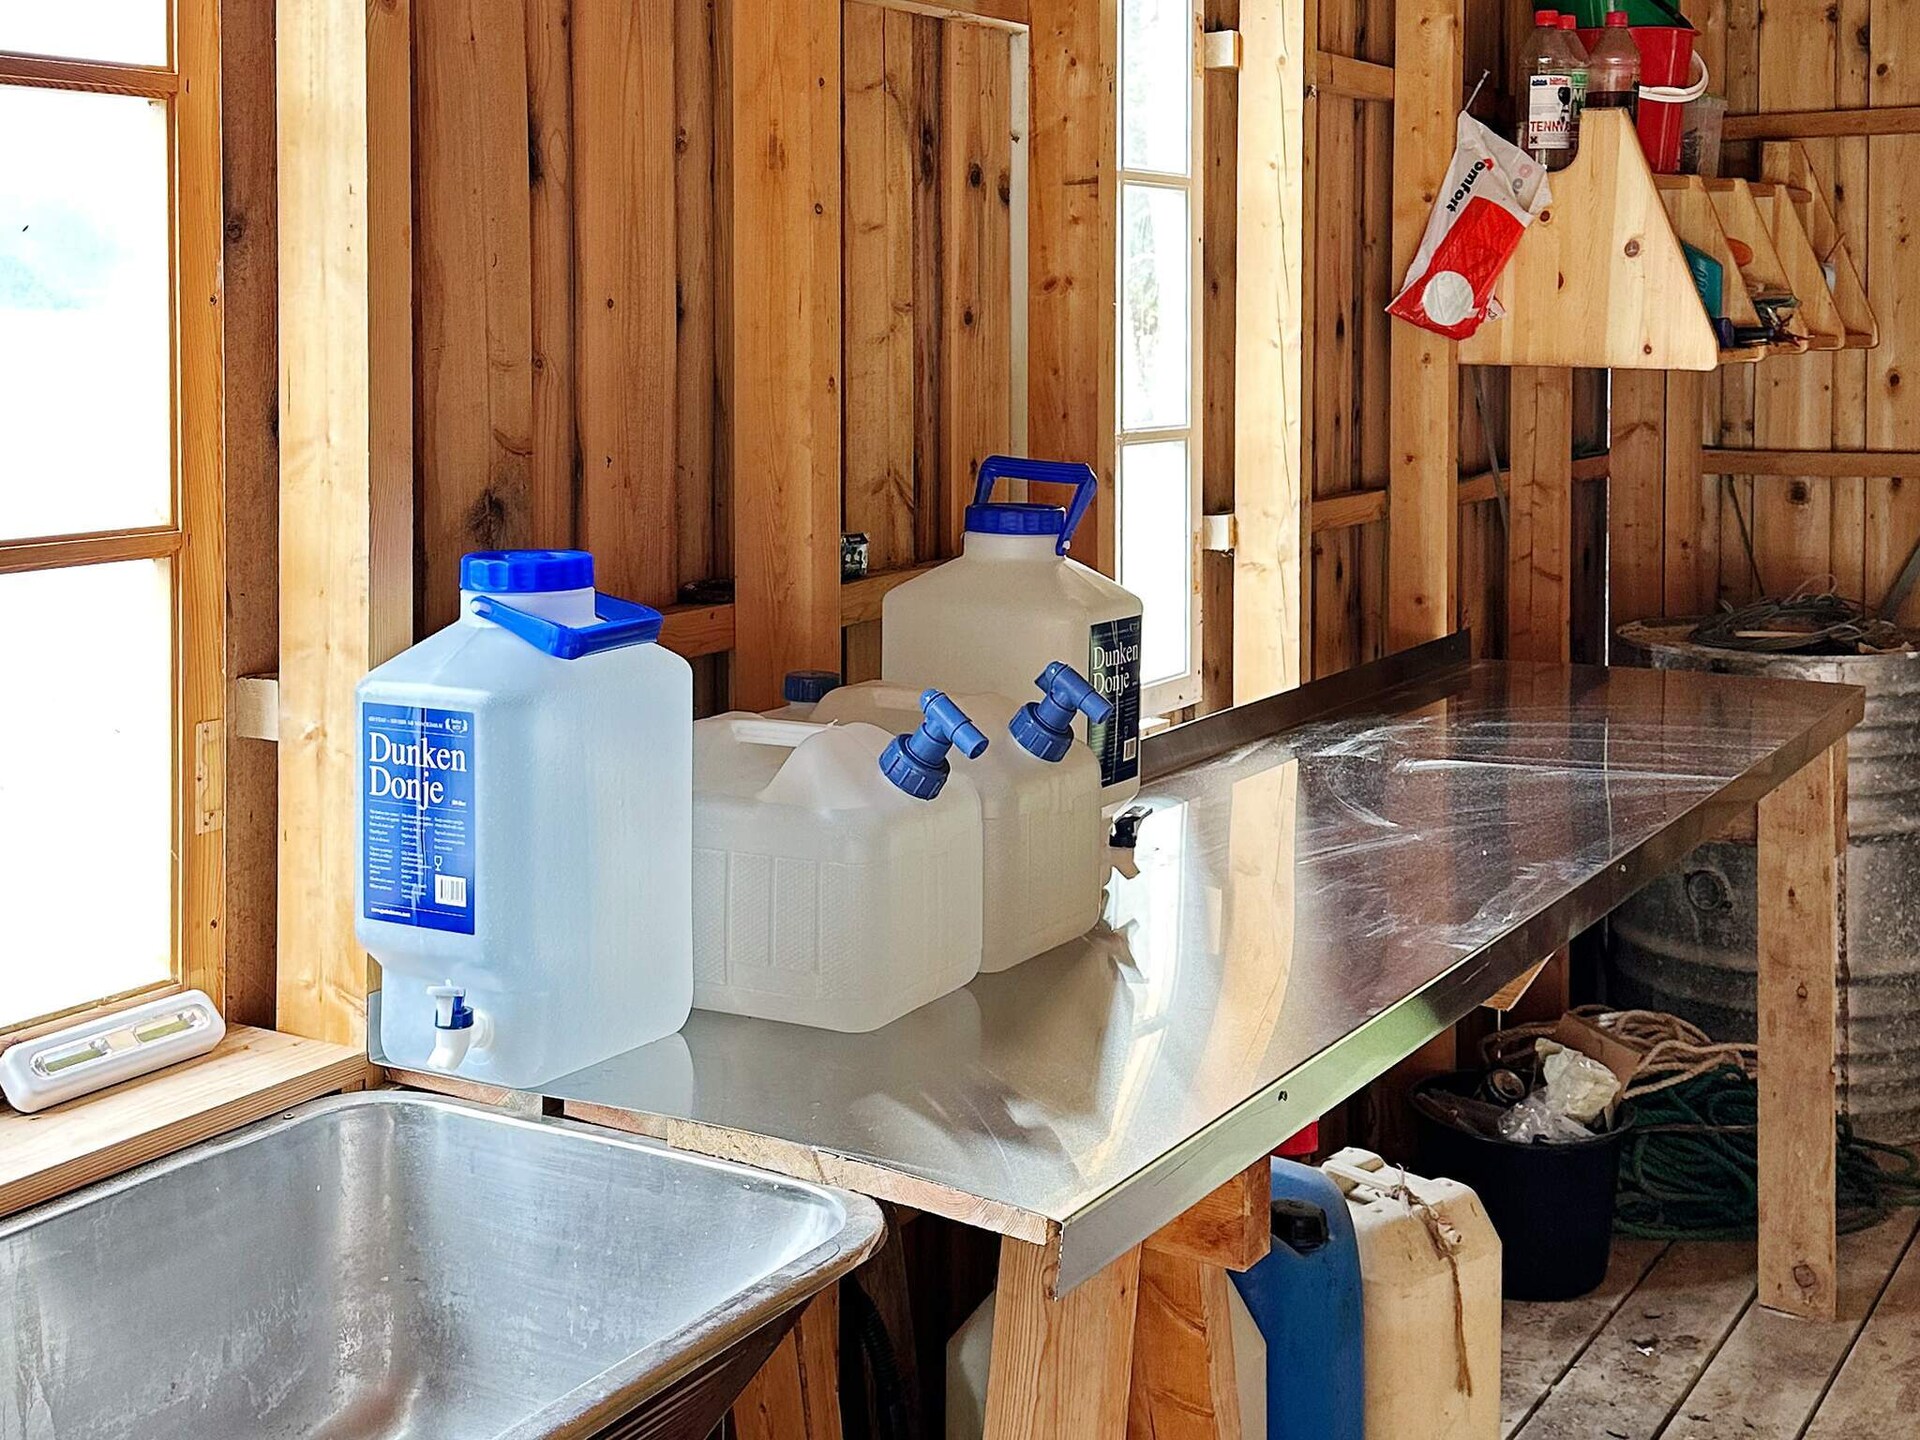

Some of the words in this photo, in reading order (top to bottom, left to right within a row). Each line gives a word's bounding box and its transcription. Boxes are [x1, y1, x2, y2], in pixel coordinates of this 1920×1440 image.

[1447, 158, 1493, 212] Comfort
[1093, 641, 1139, 669] Dunken
[1093, 667, 1130, 696] Donje
[369, 732, 467, 772] Dunken
[369, 765, 444, 810] Donje
